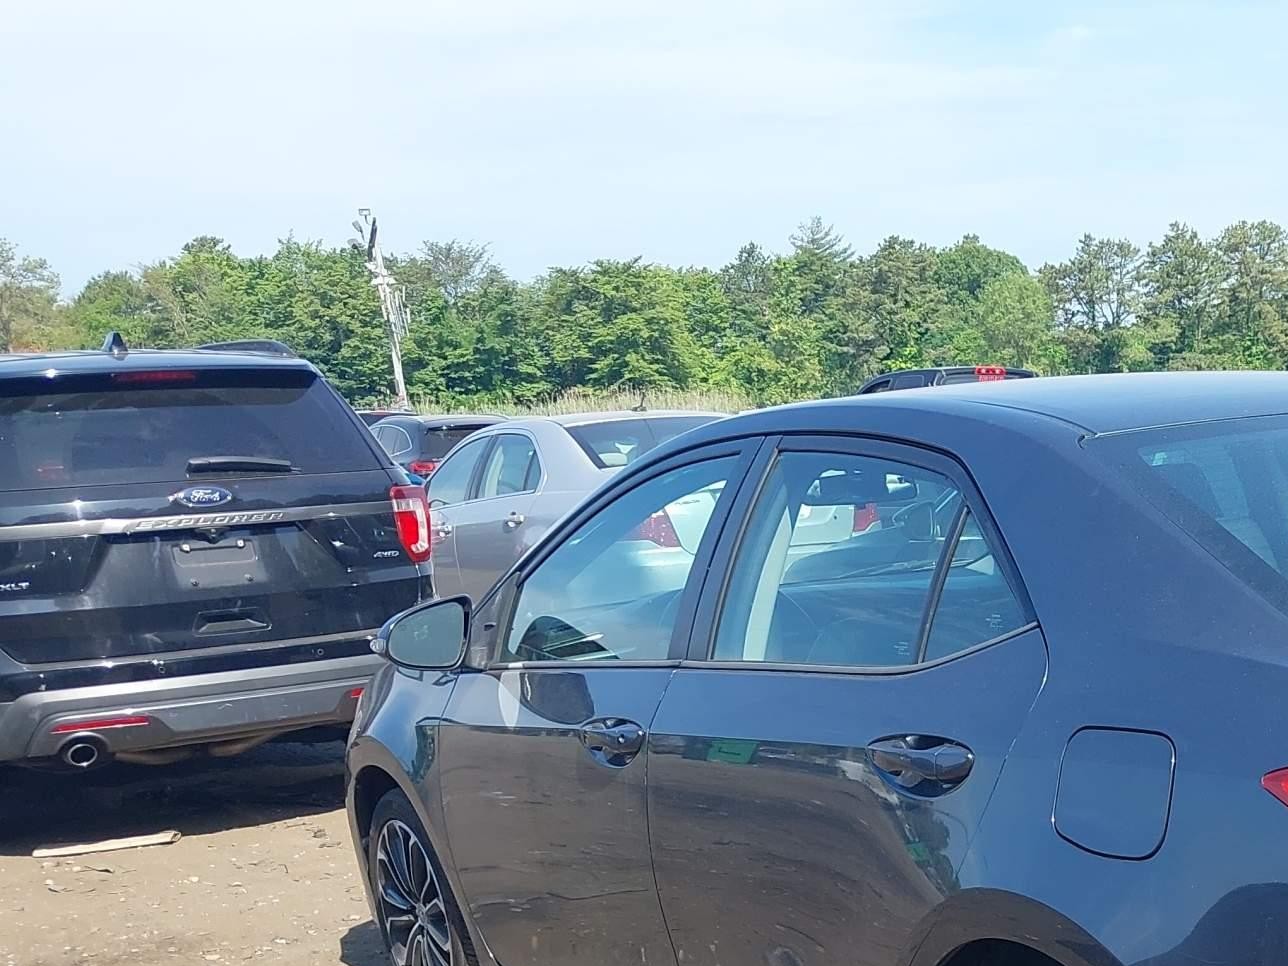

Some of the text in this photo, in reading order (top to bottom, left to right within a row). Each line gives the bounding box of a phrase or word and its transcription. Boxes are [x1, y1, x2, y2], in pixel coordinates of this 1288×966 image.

[190, 489, 220, 503] Ford
[134, 511, 285, 530] EXPLORER
[0, 582, 30, 592] XLT
